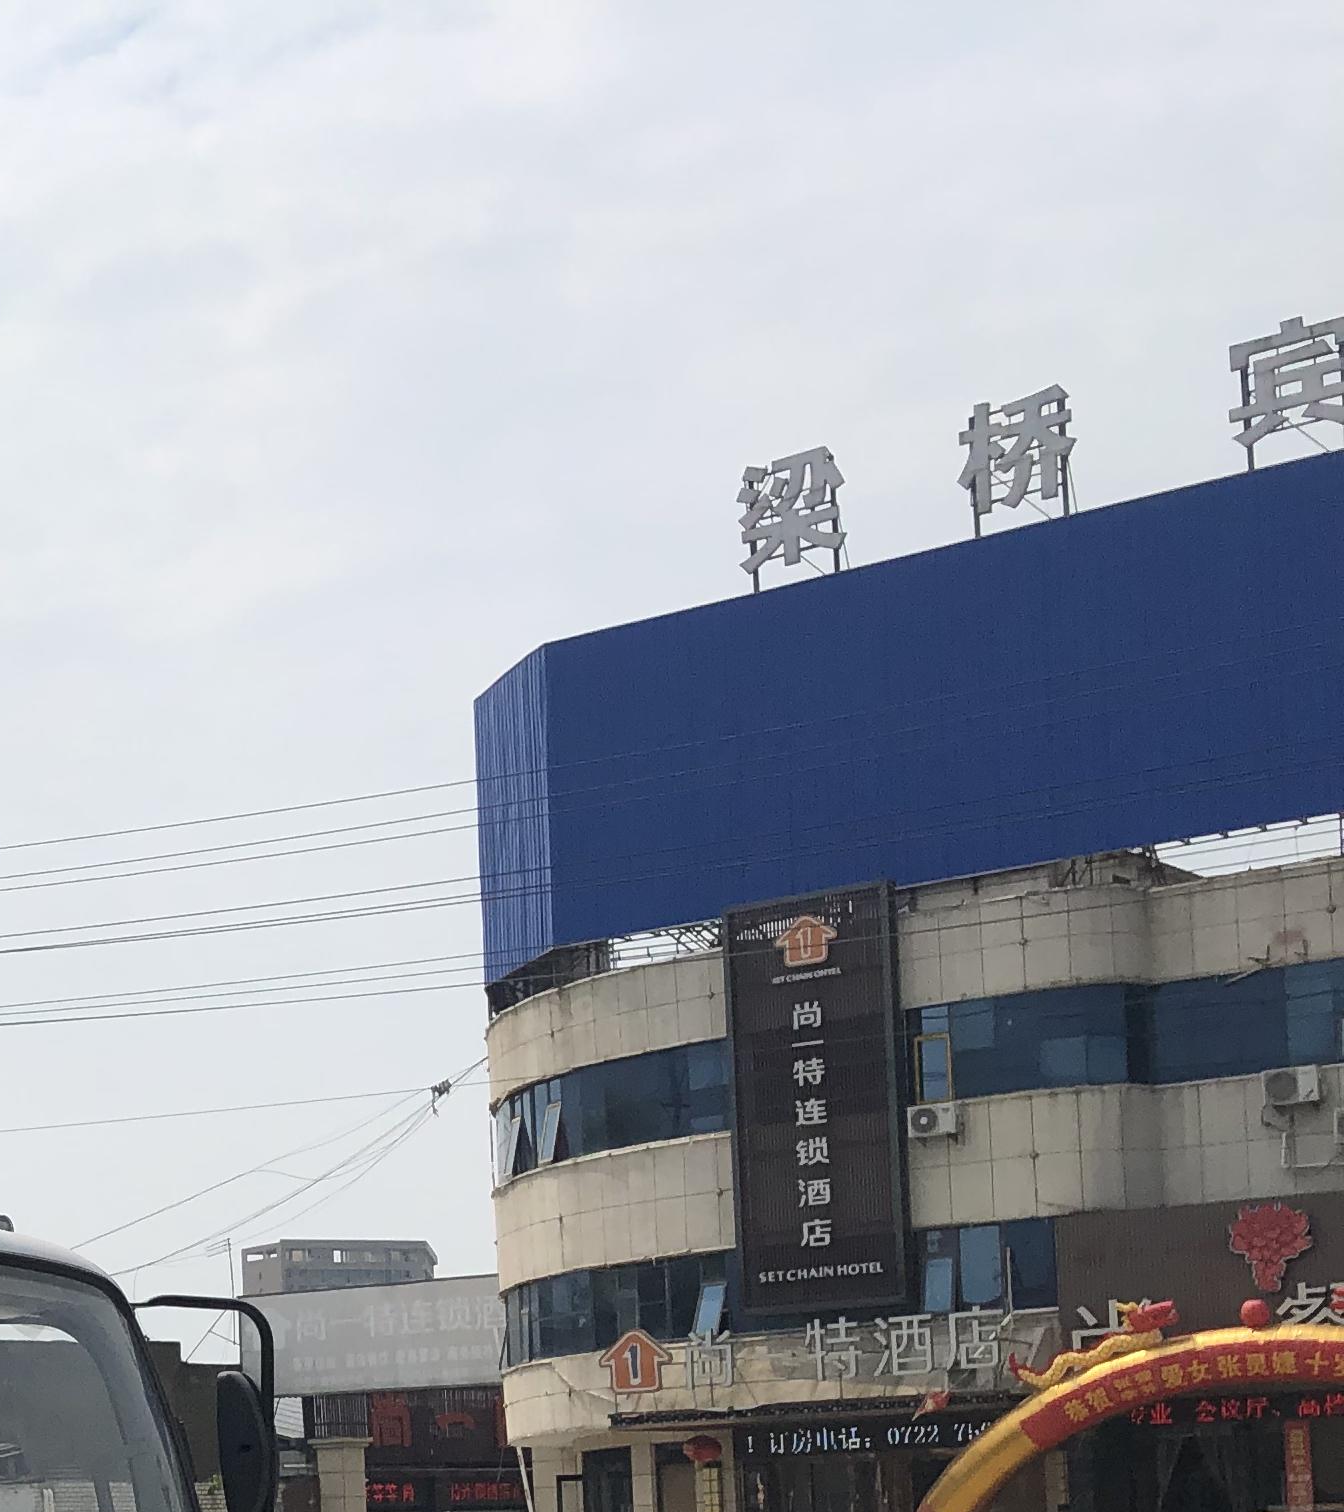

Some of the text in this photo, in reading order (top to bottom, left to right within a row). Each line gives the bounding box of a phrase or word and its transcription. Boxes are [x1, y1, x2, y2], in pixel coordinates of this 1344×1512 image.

[791, 1000, 833, 1248] 尚一特连锁酒店
[758, 1261, 884, 1284] SET CHAIN HOTEL
